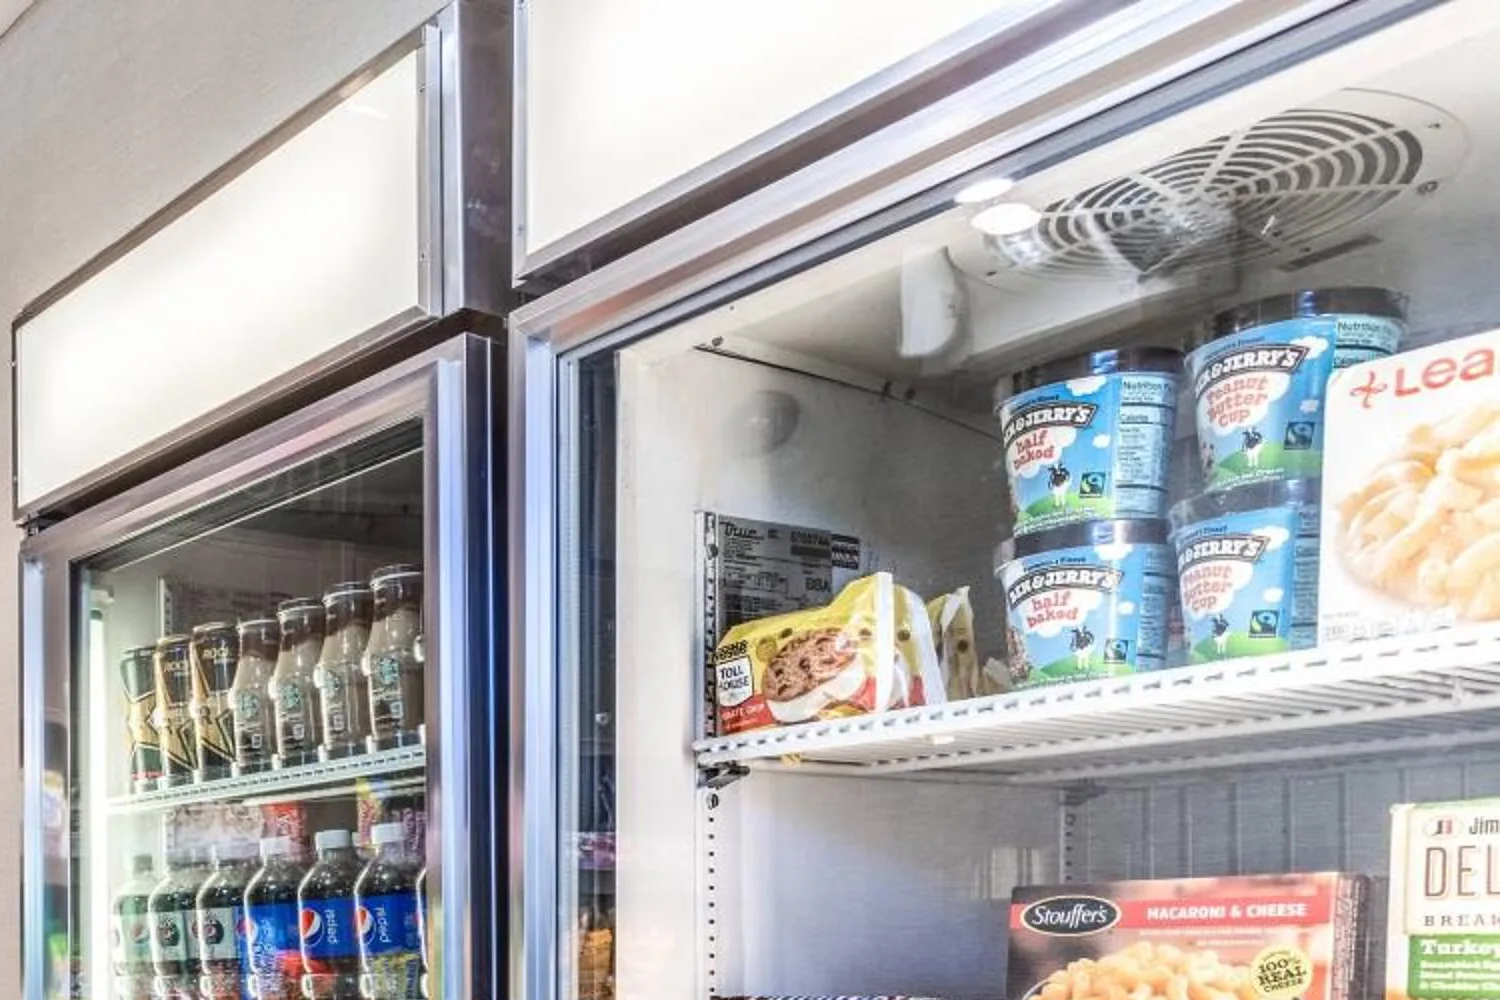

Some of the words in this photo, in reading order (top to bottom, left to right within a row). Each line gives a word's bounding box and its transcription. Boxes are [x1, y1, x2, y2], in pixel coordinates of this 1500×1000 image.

[1221, 349, 1298, 372] JERRY'S
[1394, 346, 1500, 398] Lea
[1025, 405, 1094, 429] JERRY'S
[1016, 428, 1049, 453] half
[1194, 538, 1261, 561] JERRY'S
[1045, 568, 1122, 591] JERRY'S
[1032, 591, 1071, 611] half
[1028, 606, 1079, 630] baked
[719, 666, 746, 679] TOLL
[1031, 903, 1108, 930] Stouffer's
[1146, 905, 1224, 921] MACARONI
[1230, 906, 1242, 919] &
[1246, 902, 1310, 918] CHEESE
[323, 908, 341, 946] pepsi
[374, 906, 393, 944] pepsi
[1257, 966, 1307, 986] REAL
